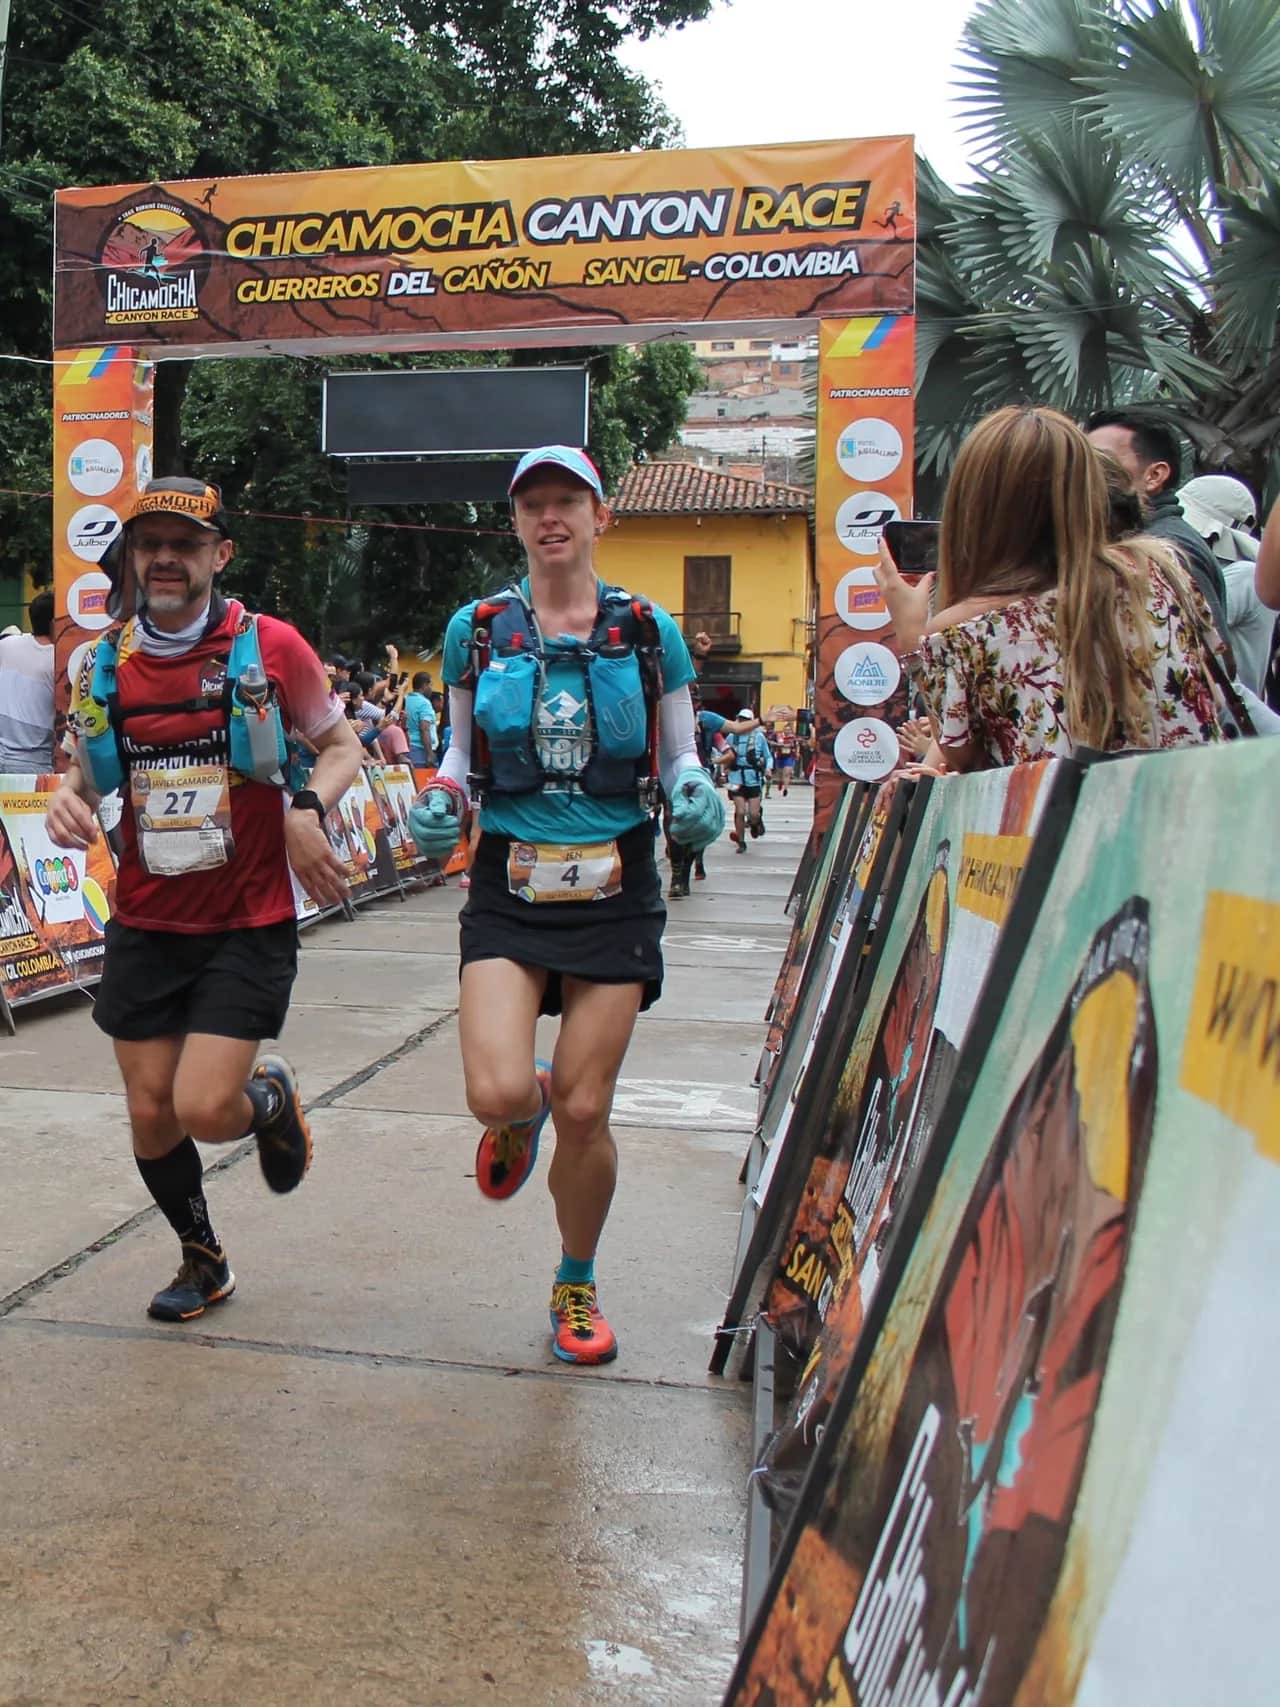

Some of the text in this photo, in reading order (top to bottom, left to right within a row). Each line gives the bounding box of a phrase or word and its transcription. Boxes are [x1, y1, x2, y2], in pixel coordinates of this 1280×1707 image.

[227, 187, 861, 257] CHICAMOCHA CANYON RACE
[236, 274, 380, 303] GUERREROS
[387, 271, 437, 296] DEL
[443, 259, 548, 292] CAÑÓN
[705, 251, 859, 281] COLOMBIA
[108, 269, 197, 311] CHICAMOCHA
[115, 310, 189, 323] CANYON RACE
[164, 791, 198, 815] 27
[561, 864, 580, 887] 4
[17, 954, 61, 977] COLOMBIA
